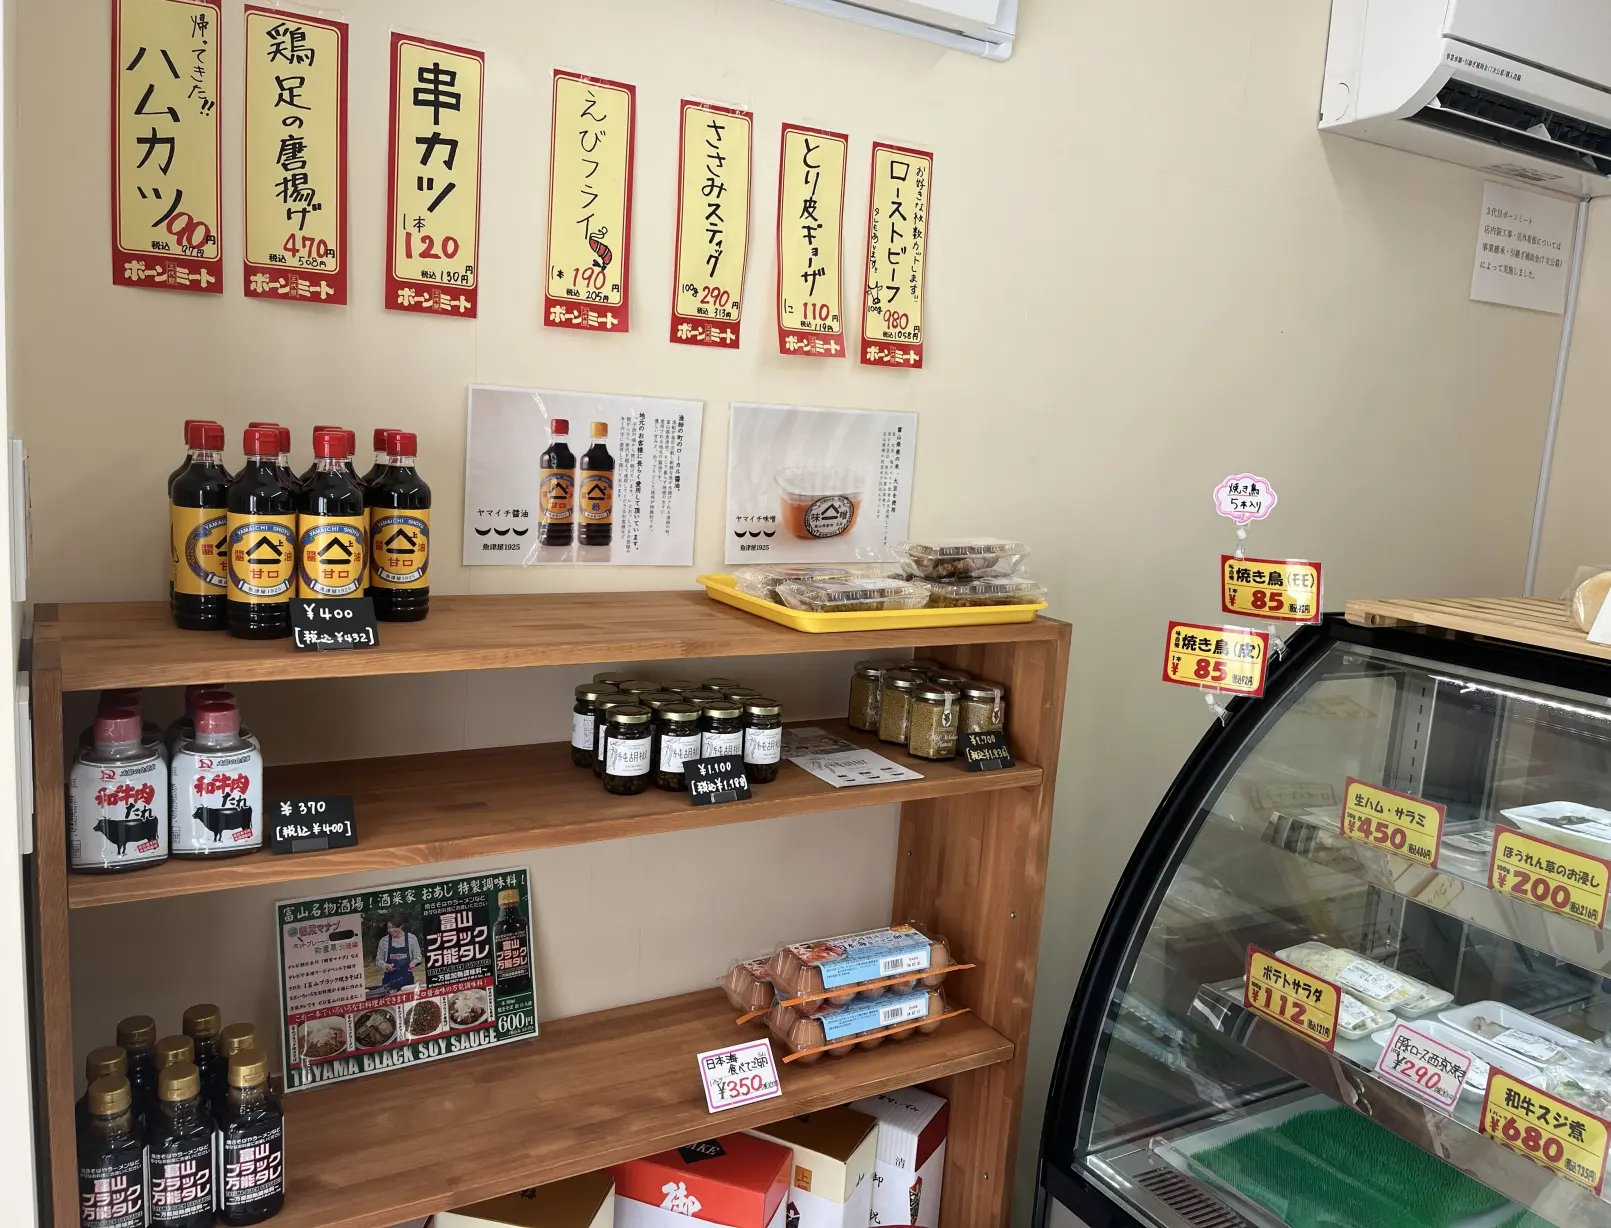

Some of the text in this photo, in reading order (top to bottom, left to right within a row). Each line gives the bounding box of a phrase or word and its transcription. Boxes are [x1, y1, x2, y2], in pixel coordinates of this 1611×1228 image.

[125, 46, 183, 228] ハムカツ
[266, 22, 322, 231] 鶏足の唐揚げ
[412, 62, 461, 213] 串カツ
[577, 90, 607, 240] えびフライ
[800, 138, 826, 297] とり皮ギョーザ
[885, 160, 910, 303] ローストビーフ
[151, 241, 171, 251] 税込
[268, 253, 287, 264] 税込
[421, 270, 437, 279] 税込
[573, 266, 606, 290] 190
[566, 288, 581, 298] 税込
[699, 285, 730, 308] 290
[696, 306, 709, 316] 税込
[802, 301, 830, 321] 110
[883, 309, 909, 330] 980
[800, 320, 812, 328] 税込
[1228, 482, 1260, 496] 焼き鳥
[387, 557, 414, 567] 甘口
[250, 568, 279, 580] 甘口
[322, 568, 350, 580] 甘口
[95, 782, 156, 809] 和牛肉
[194, 772, 250, 798] 和牛肉
[125, 802, 156, 821] たれ
[221, 791, 250, 811] たれ
[1354, 793, 1426, 828] 生ハム・サラミ
[1503, 845, 1601, 888] ほうれん草のお浸し
[440, 910, 473, 931] 富山
[426, 925, 488, 950] ブラック
[426, 944, 490, 968] 万能タレ
[1262, 964, 1324, 1004] ポテトサラダ
[363, 1044, 417, 1072] BLACK
[418, 1038, 448, 1060] SOY
[451, 1027, 498, 1053] SAUCE
[1504, 1087, 1587, 1144] 和牛スジ煮
[226, 1150, 281, 1177] ブラック
[239, 1143, 270, 1163] 富山
[152, 1168, 210, 1191] ブラック
[164, 1160, 196, 1178] 富山
[225, 1165, 282, 1191] 万能タレ
[82, 1184, 141, 1206] ブラック
[94, 1175, 127, 1193] 富山
[151, 1183, 211, 1206] 万能タレ
[82, 1199, 142, 1221] 万能タレ
